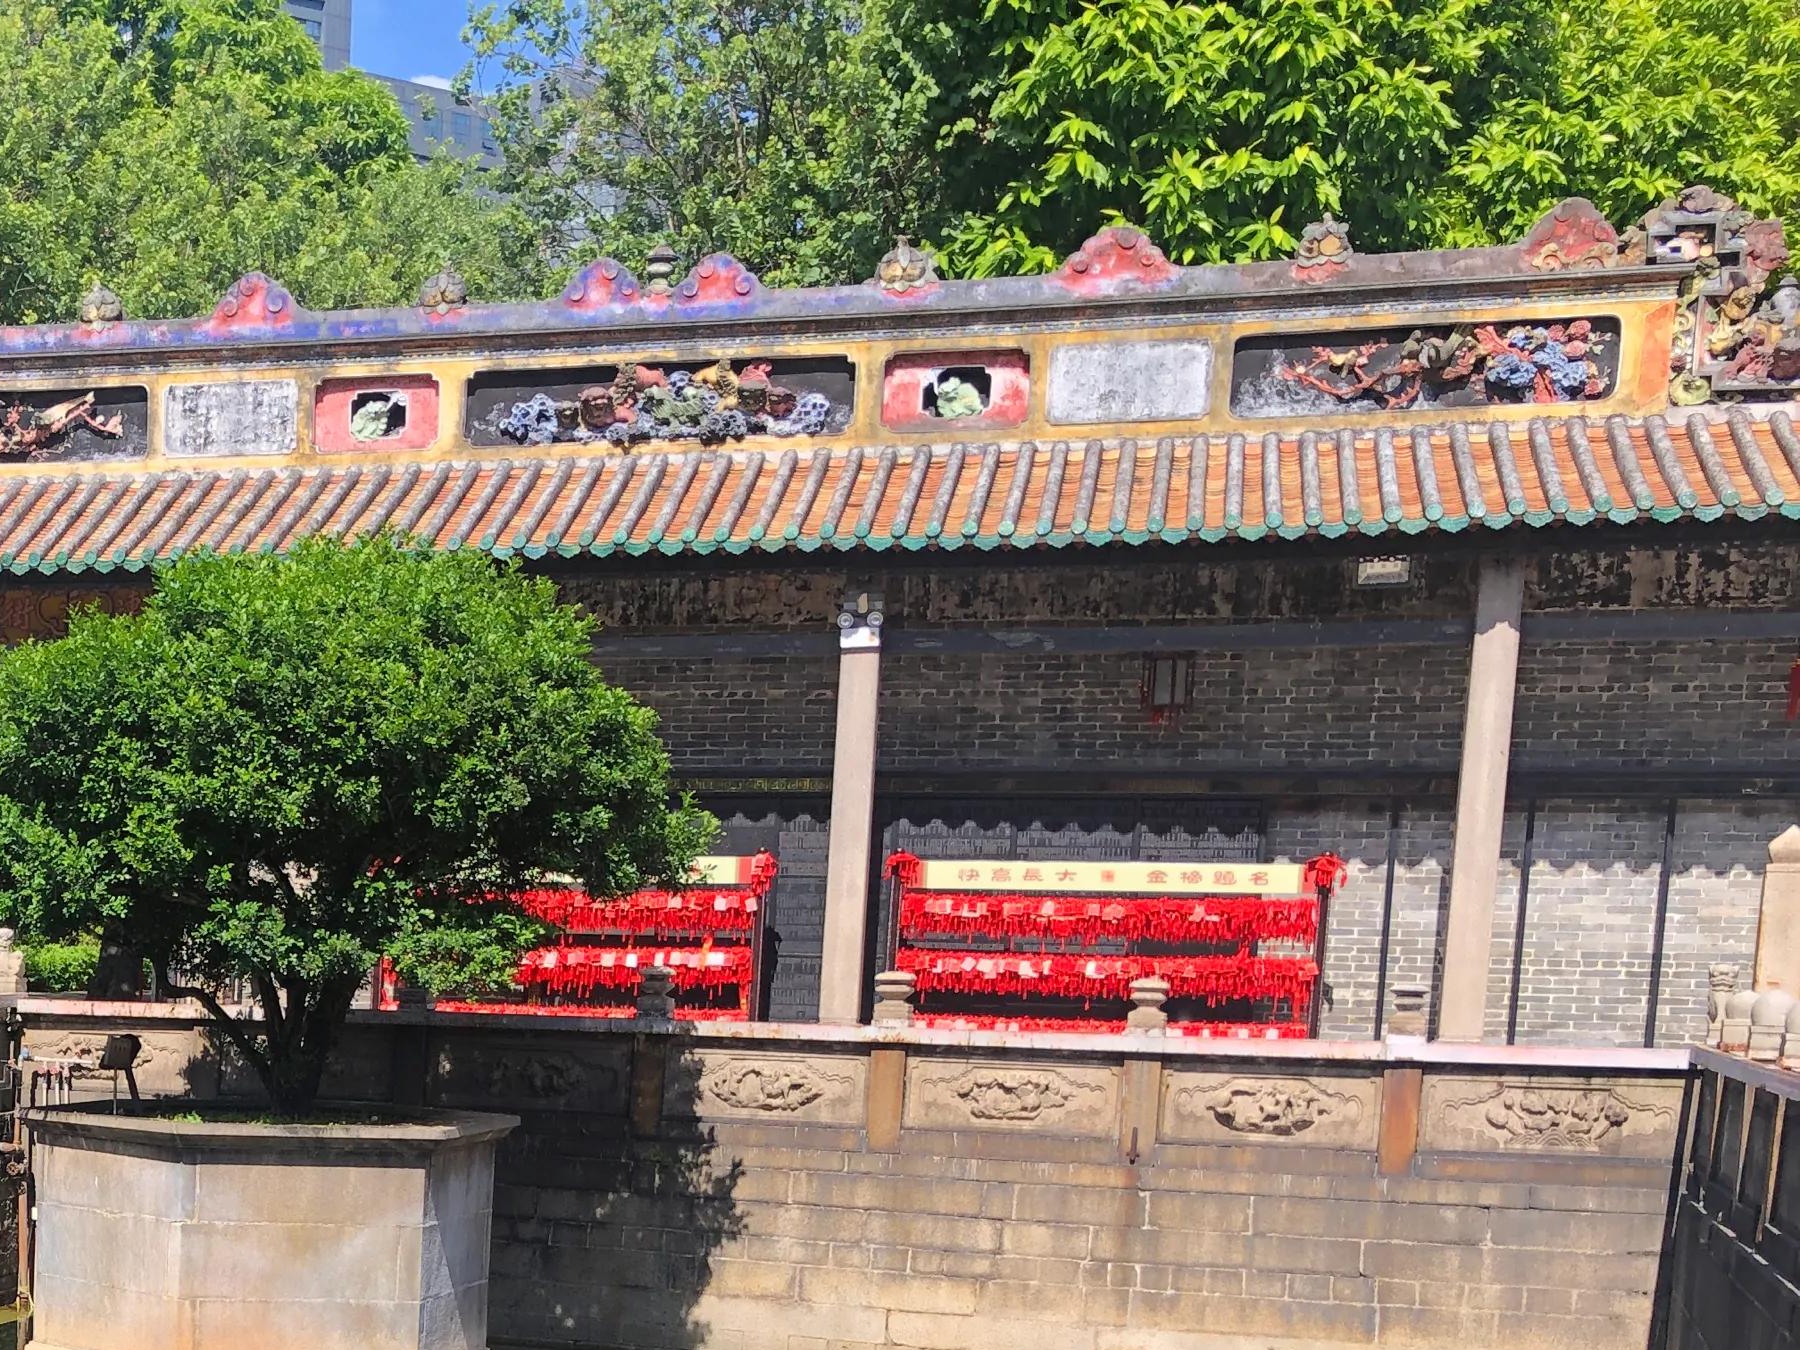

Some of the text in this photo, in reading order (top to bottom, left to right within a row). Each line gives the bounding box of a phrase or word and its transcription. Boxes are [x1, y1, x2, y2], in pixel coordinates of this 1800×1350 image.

[958, 868, 1077, 882] 快高長大
[1146, 870, 1269, 886] 金榜題名
